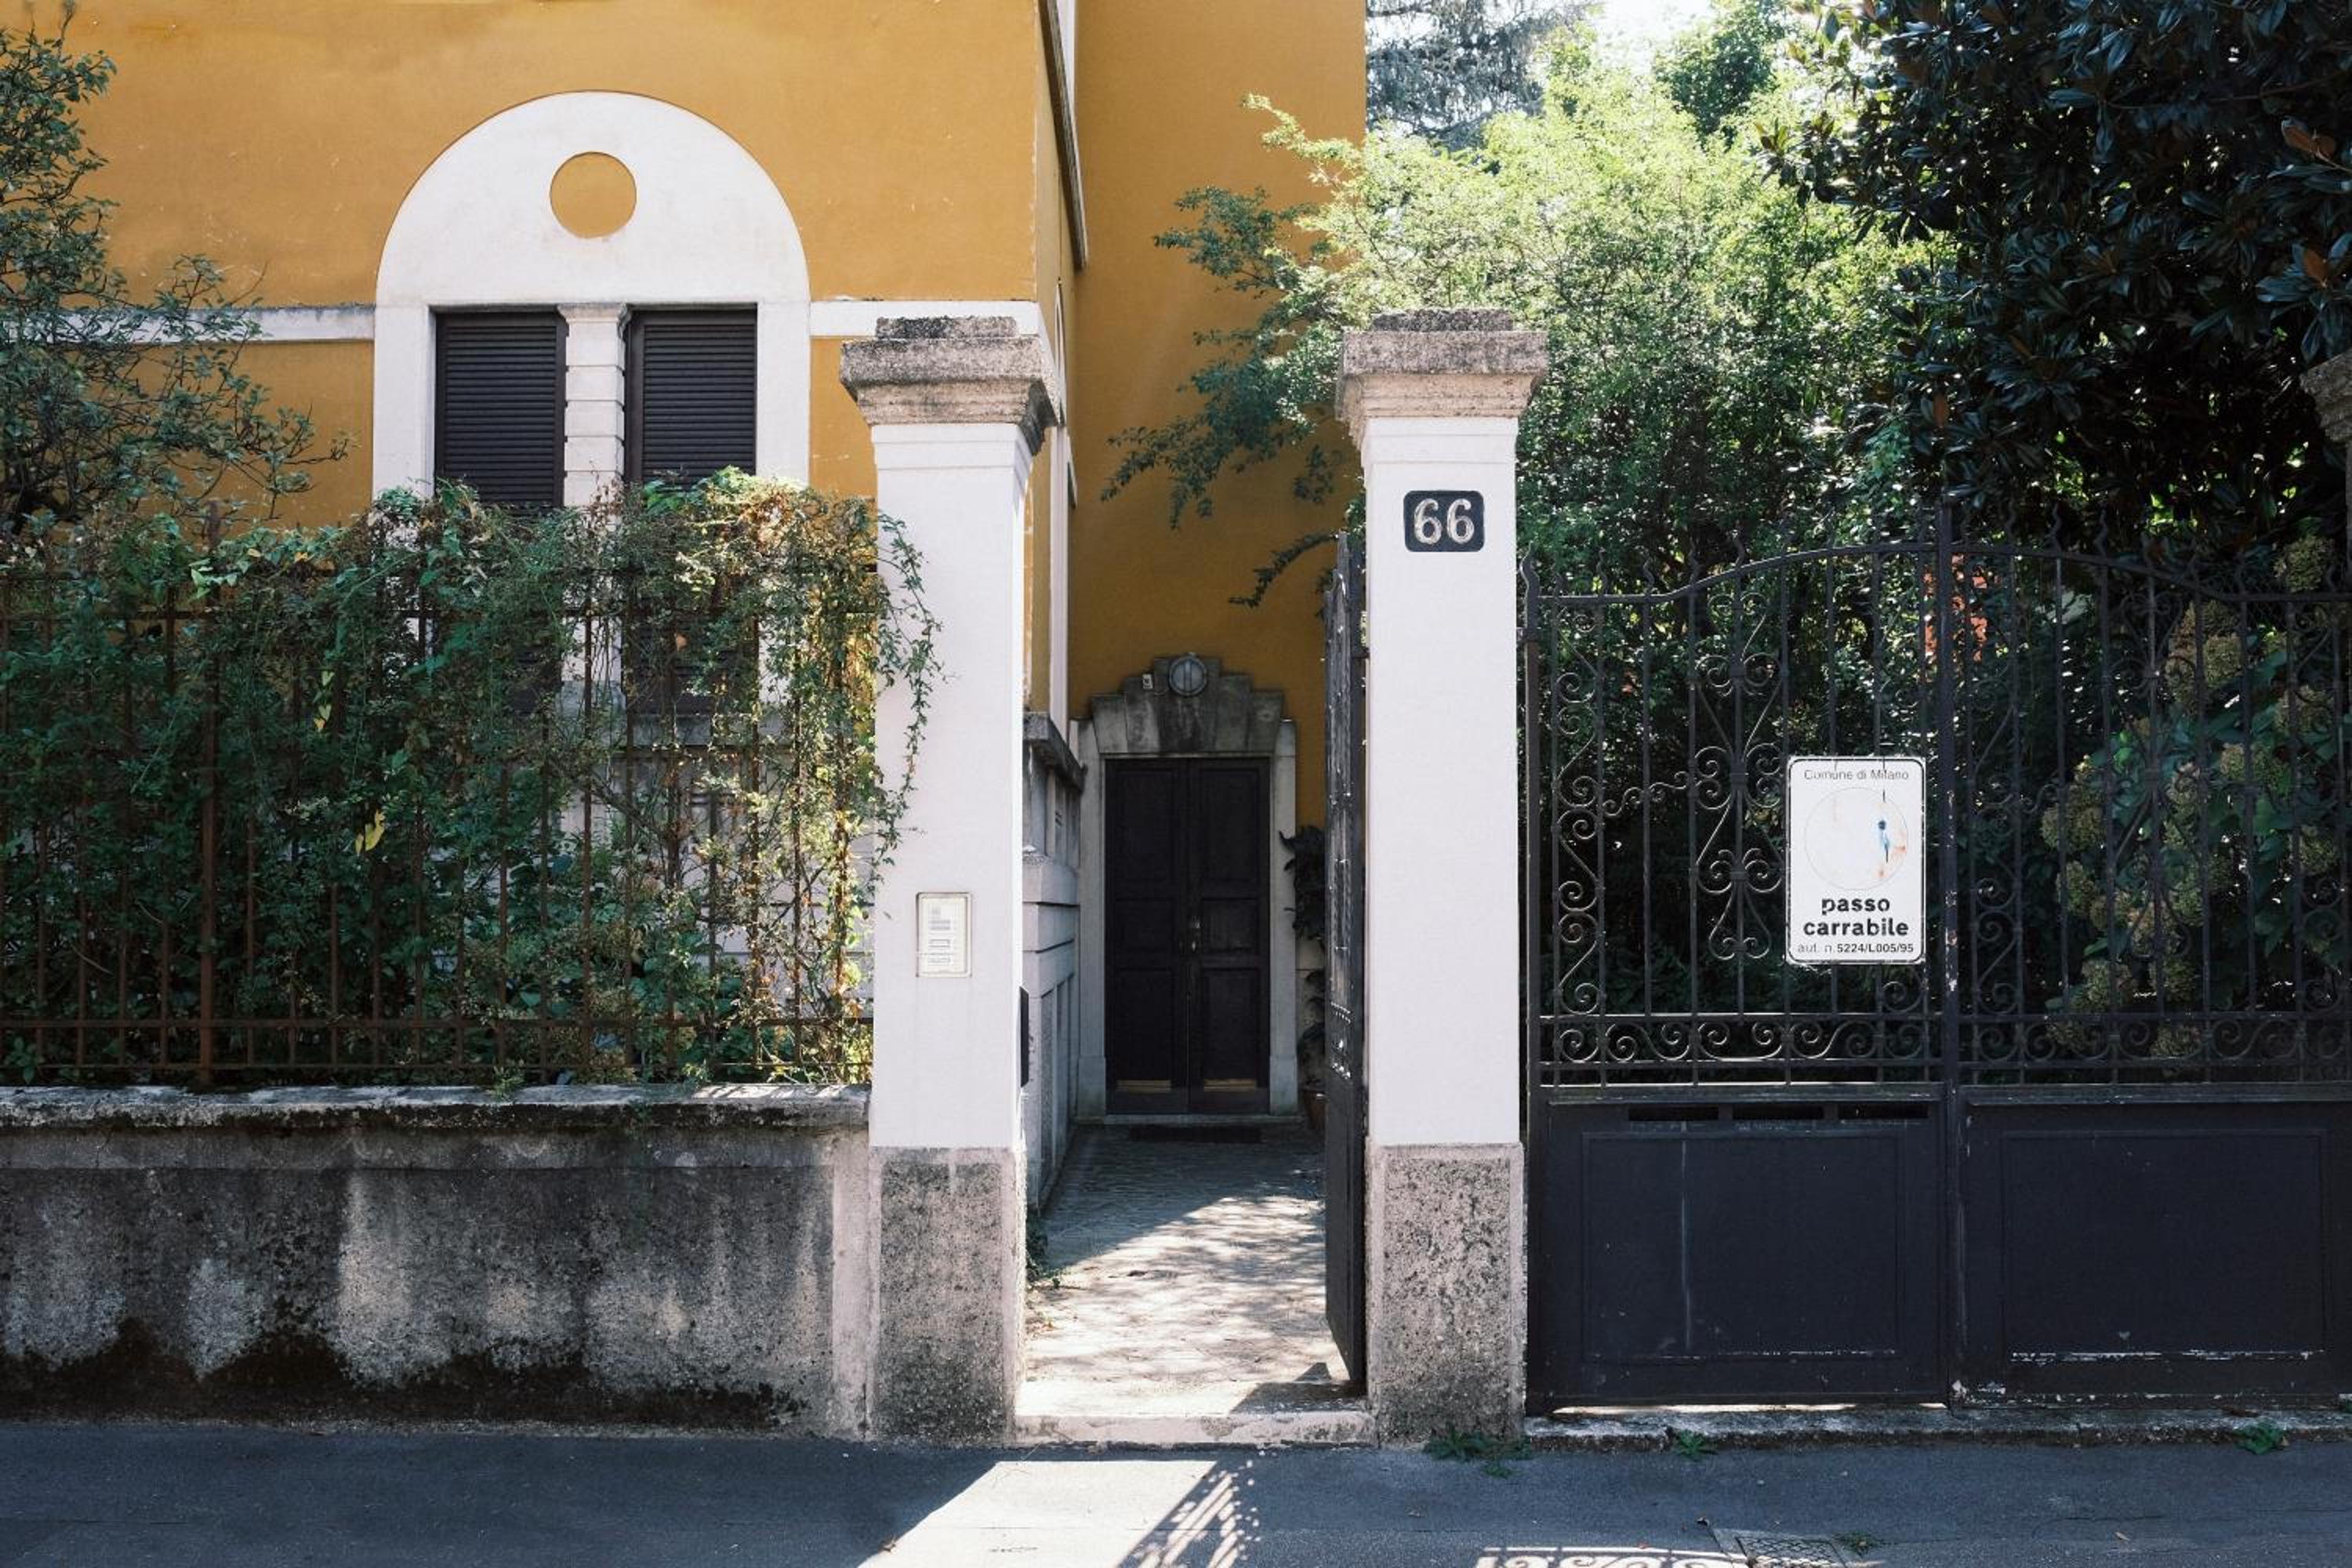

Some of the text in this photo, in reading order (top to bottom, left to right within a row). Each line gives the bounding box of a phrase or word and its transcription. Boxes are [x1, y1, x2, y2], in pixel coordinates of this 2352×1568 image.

[1414, 498, 1475, 544] 66
[1804, 769, 1909, 779] Comune di Milano
[1821, 898, 1890, 916] passo
[1803, 917, 1909, 935] carrabile
[1837, 943, 1914, 953] 5224/L005/95
